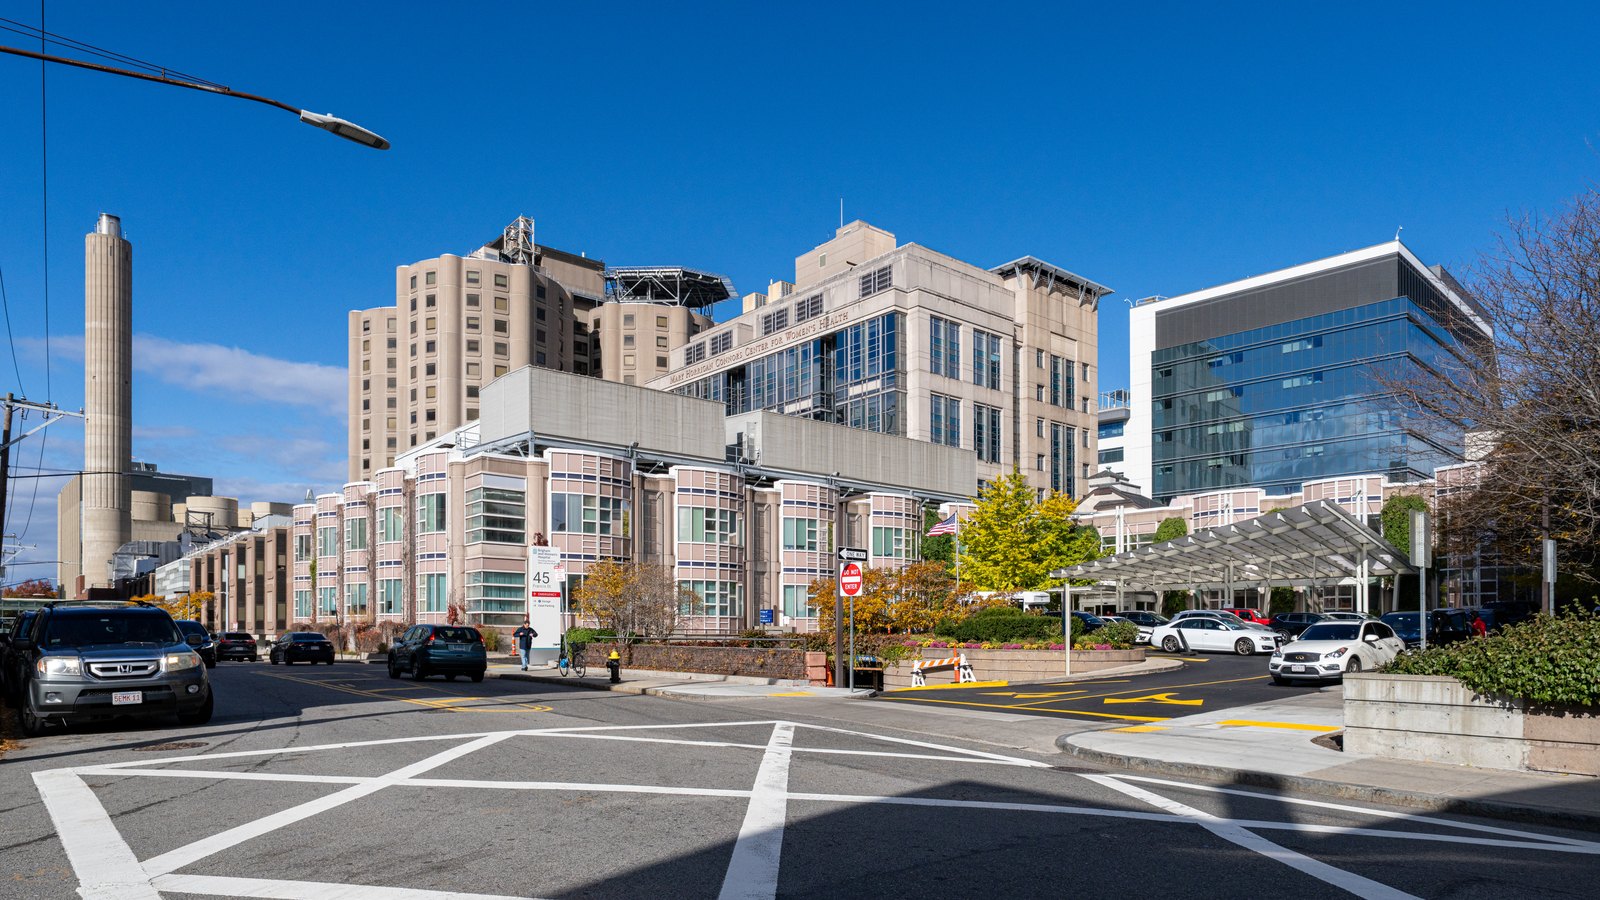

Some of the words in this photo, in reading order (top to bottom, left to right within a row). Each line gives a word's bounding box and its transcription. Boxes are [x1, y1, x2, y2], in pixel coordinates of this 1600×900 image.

[670, 373, 684, 385] MARY
[686, 362, 714, 378] HORRIGAN
[715, 354, 743, 367] CONNORS
[745, 344, 769, 357] CENTER
[771, 337, 783, 347] FOR
[785, 324, 816, 340] WOMEN'S
[819, 311, 849, 330] HEALTH
[533, 571, 550, 584] 45
